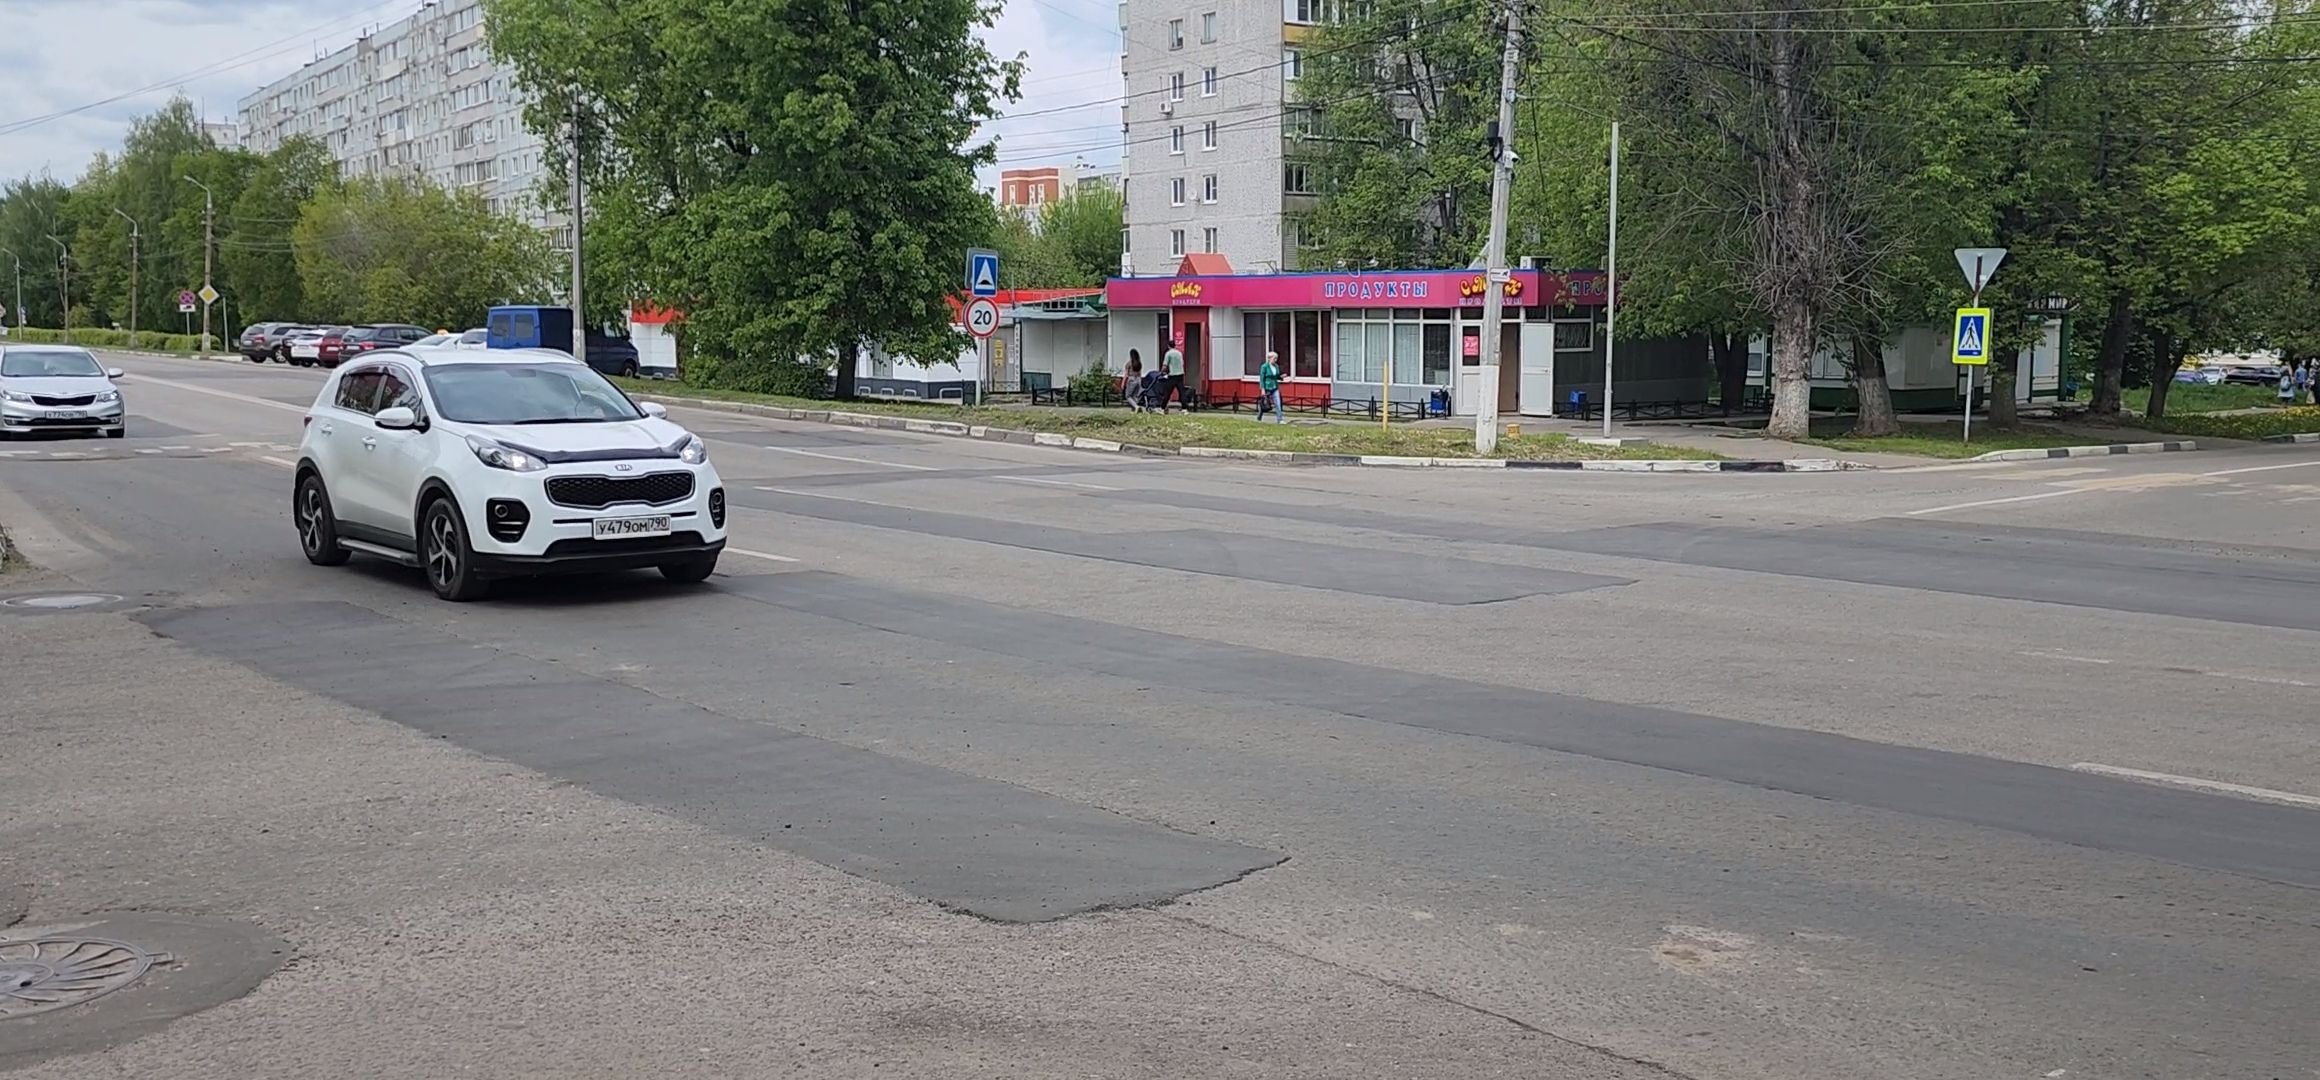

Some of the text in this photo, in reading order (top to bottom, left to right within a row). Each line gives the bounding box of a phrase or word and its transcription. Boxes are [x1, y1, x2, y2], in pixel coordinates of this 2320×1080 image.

[1325, 281, 1428, 299] ПРОДУКТЫ
[973, 310, 992, 325] 20
[600, 517, 668, 535] У479ОМ 790
